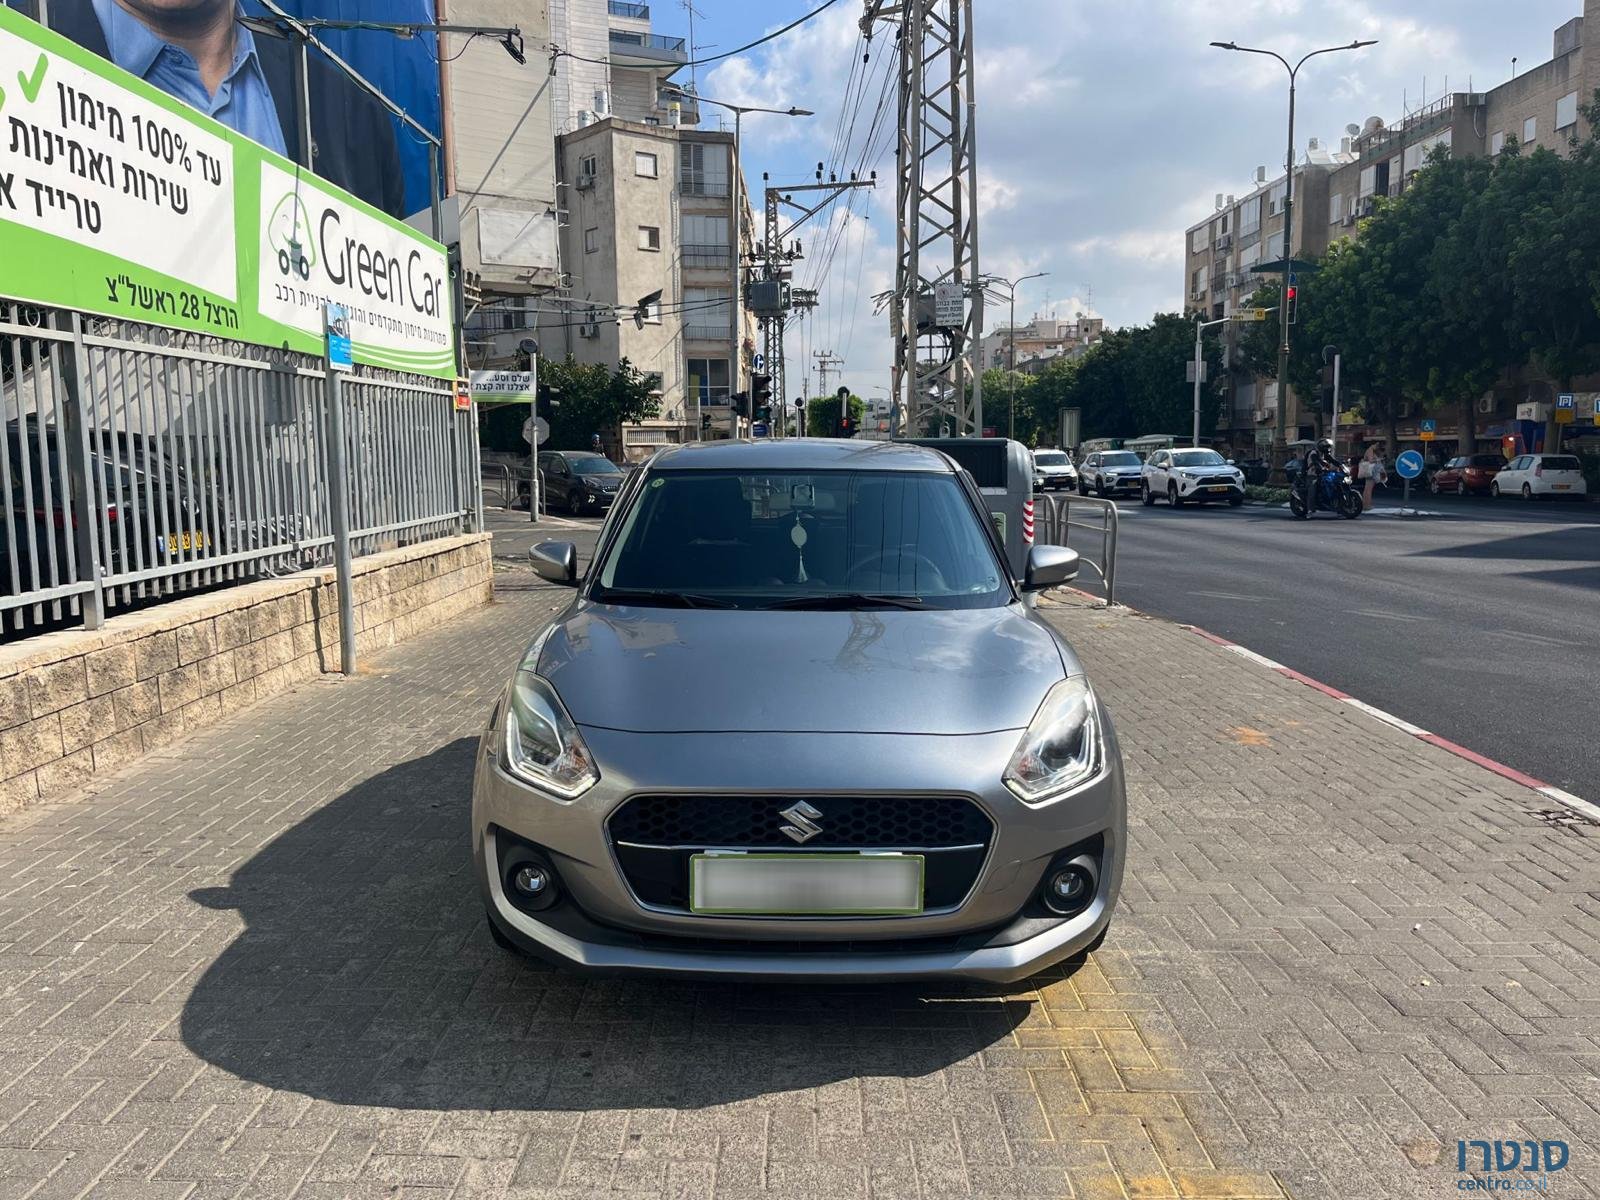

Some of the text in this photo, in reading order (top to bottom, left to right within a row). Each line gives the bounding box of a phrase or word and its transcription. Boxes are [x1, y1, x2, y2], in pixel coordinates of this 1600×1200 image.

[56, 81, 222, 186] עד 100% מימון
[8, 115, 188, 215] שירות ואמינות
[25, 178, 101, 234] טרייד
[320, 208, 442, 319] Green Car
[275, 283, 296, 304] רכב
[180, 291, 200, 320] 28
[203, 296, 239, 329] הרצל
[336, 302, 366, 323] והוג
[369, 312, 403, 334] מתקדמים
[404, 322, 422, 339] מימון
[475, 383, 493, 392] קצת
[507, 382, 530, 391] אצלנו
[511, 373, 530, 382] שלם
